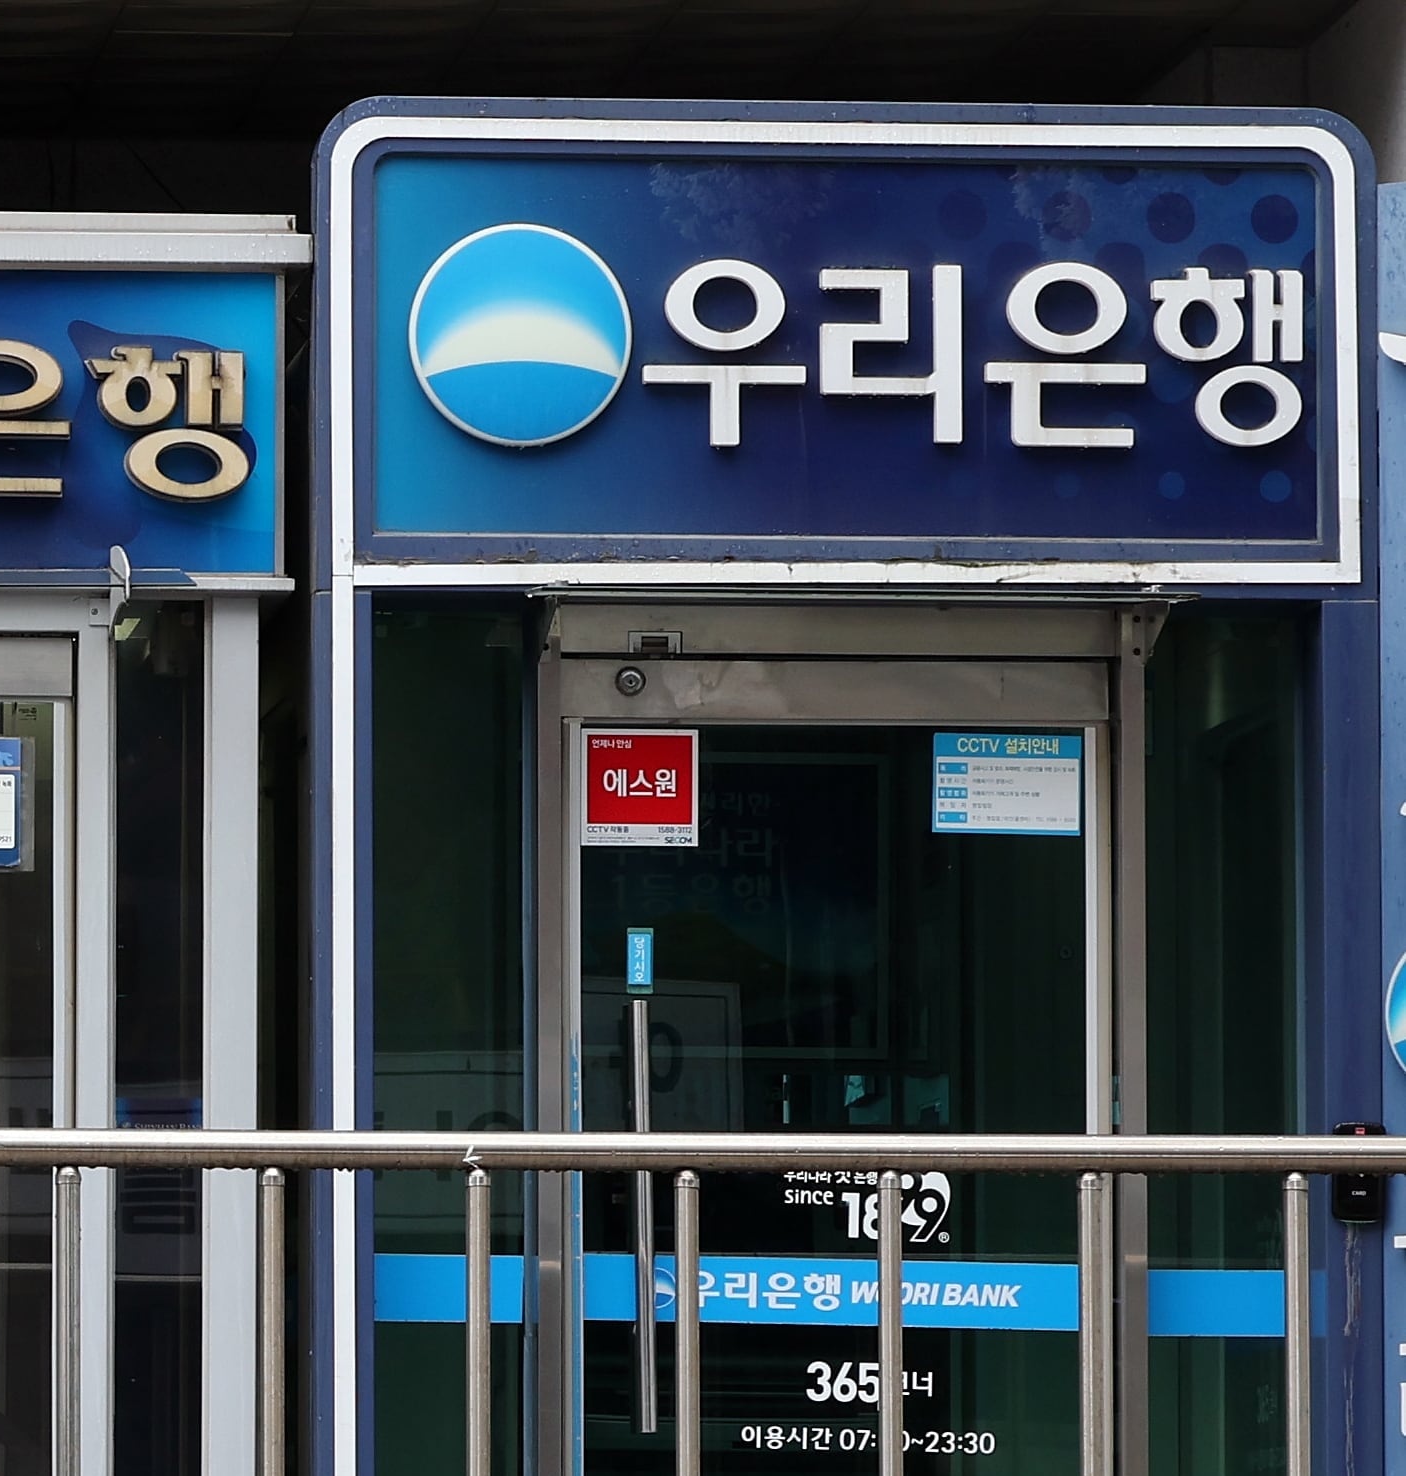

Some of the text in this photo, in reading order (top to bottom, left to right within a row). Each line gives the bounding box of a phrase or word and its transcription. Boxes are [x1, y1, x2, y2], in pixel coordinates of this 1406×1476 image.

[641, 258, 1304, 448] 우리은행
[957, 738, 1059, 754] CCTV 설치안내
[603, 768, 676, 797] 에스원
[587, 825, 609, 833] CCTV
[941, 1284, 1022, 1308] BANK
[740, 1425, 833, 1452] 이용시간
